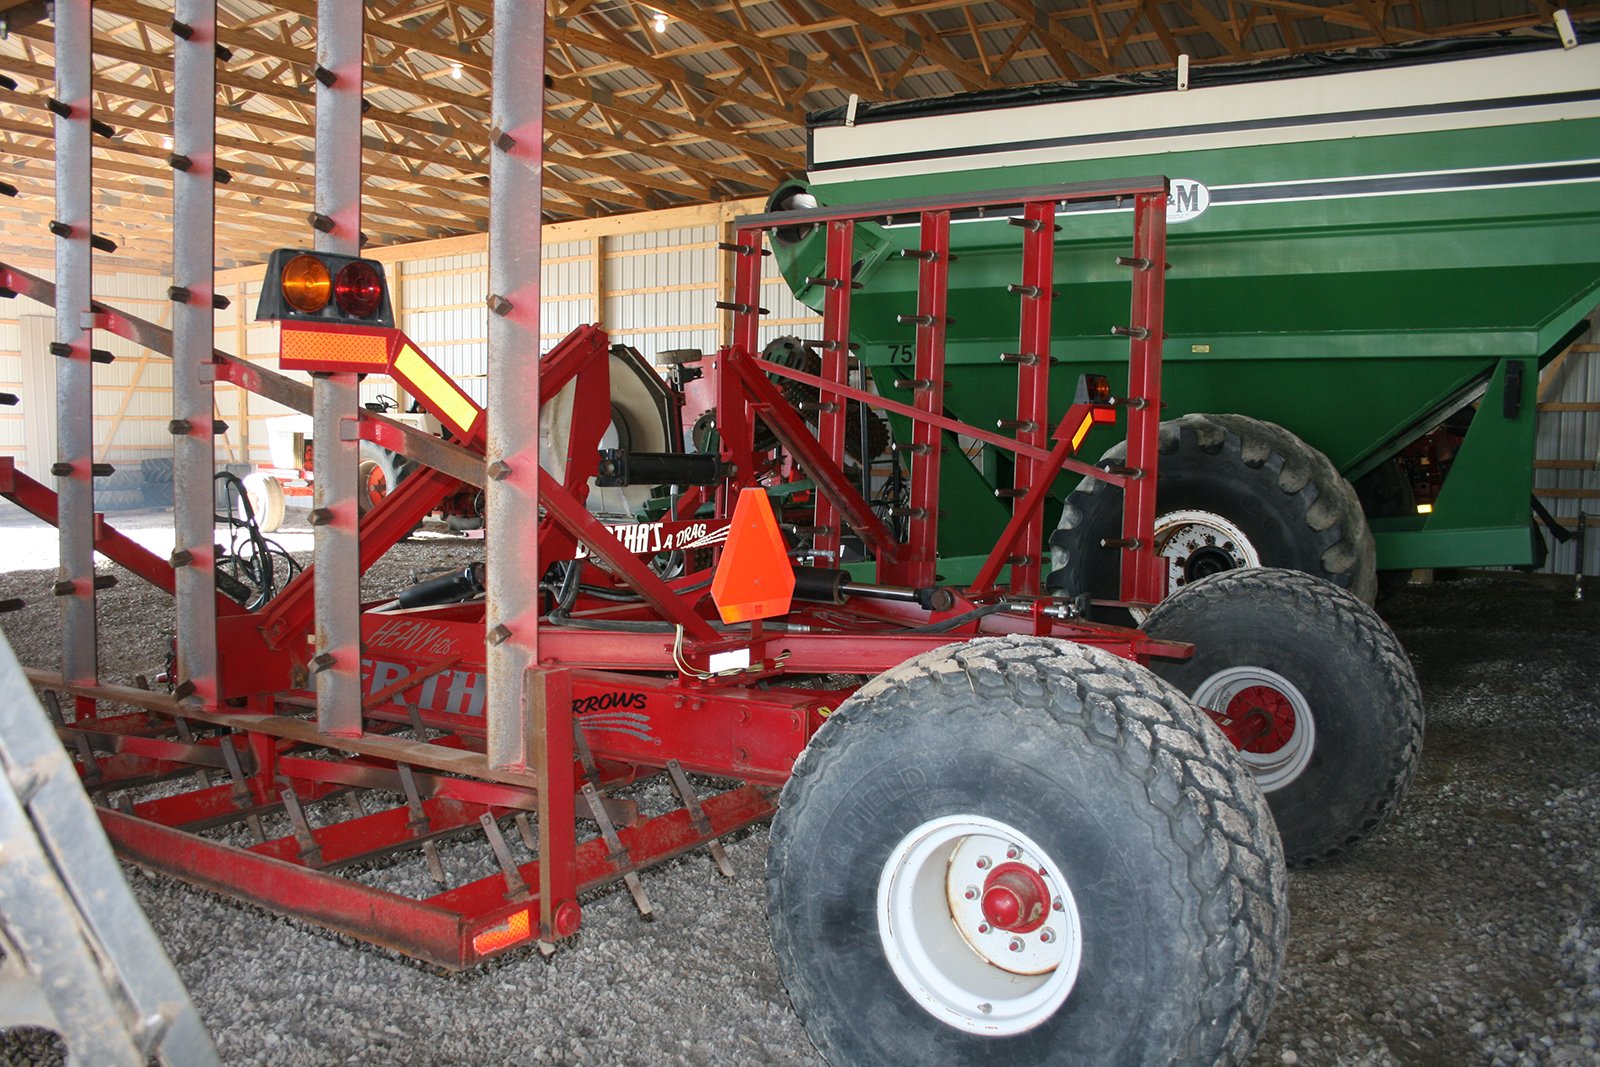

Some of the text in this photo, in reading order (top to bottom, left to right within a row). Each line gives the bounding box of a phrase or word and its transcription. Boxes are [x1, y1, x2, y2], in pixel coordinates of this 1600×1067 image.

[888, 345, 912, 363] 75
[662, 534, 673, 549] A
[676, 523, 706, 548] DRAG
[367, 619, 450, 653] HEAVY
